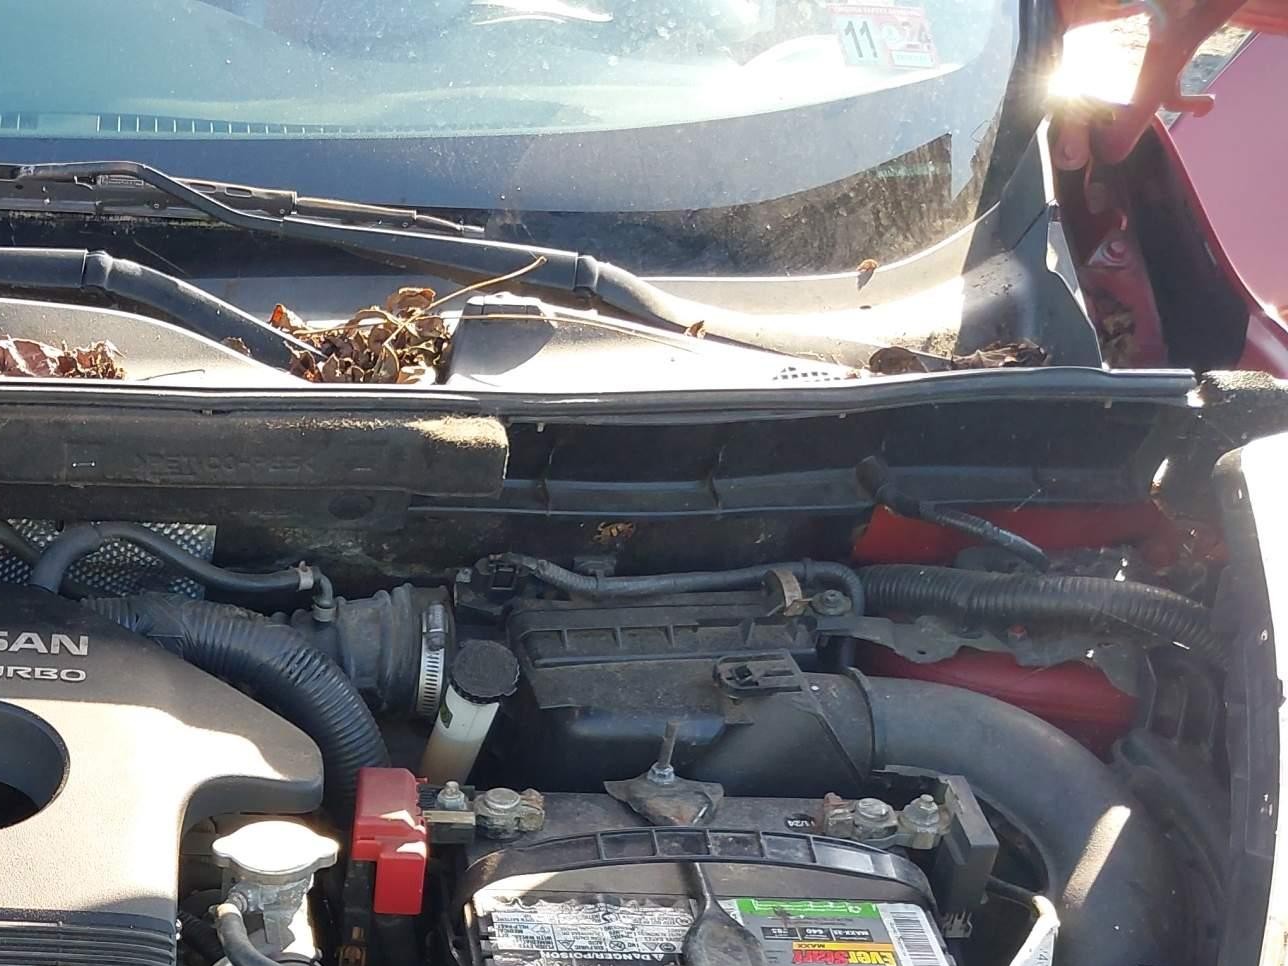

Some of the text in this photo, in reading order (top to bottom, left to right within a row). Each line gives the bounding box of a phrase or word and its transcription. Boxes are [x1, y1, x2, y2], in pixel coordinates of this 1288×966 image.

[844, 20, 878, 58] 11
[540, 952, 651, 960] DANGER/POISON
[792, 950, 897, 966] EverStart
